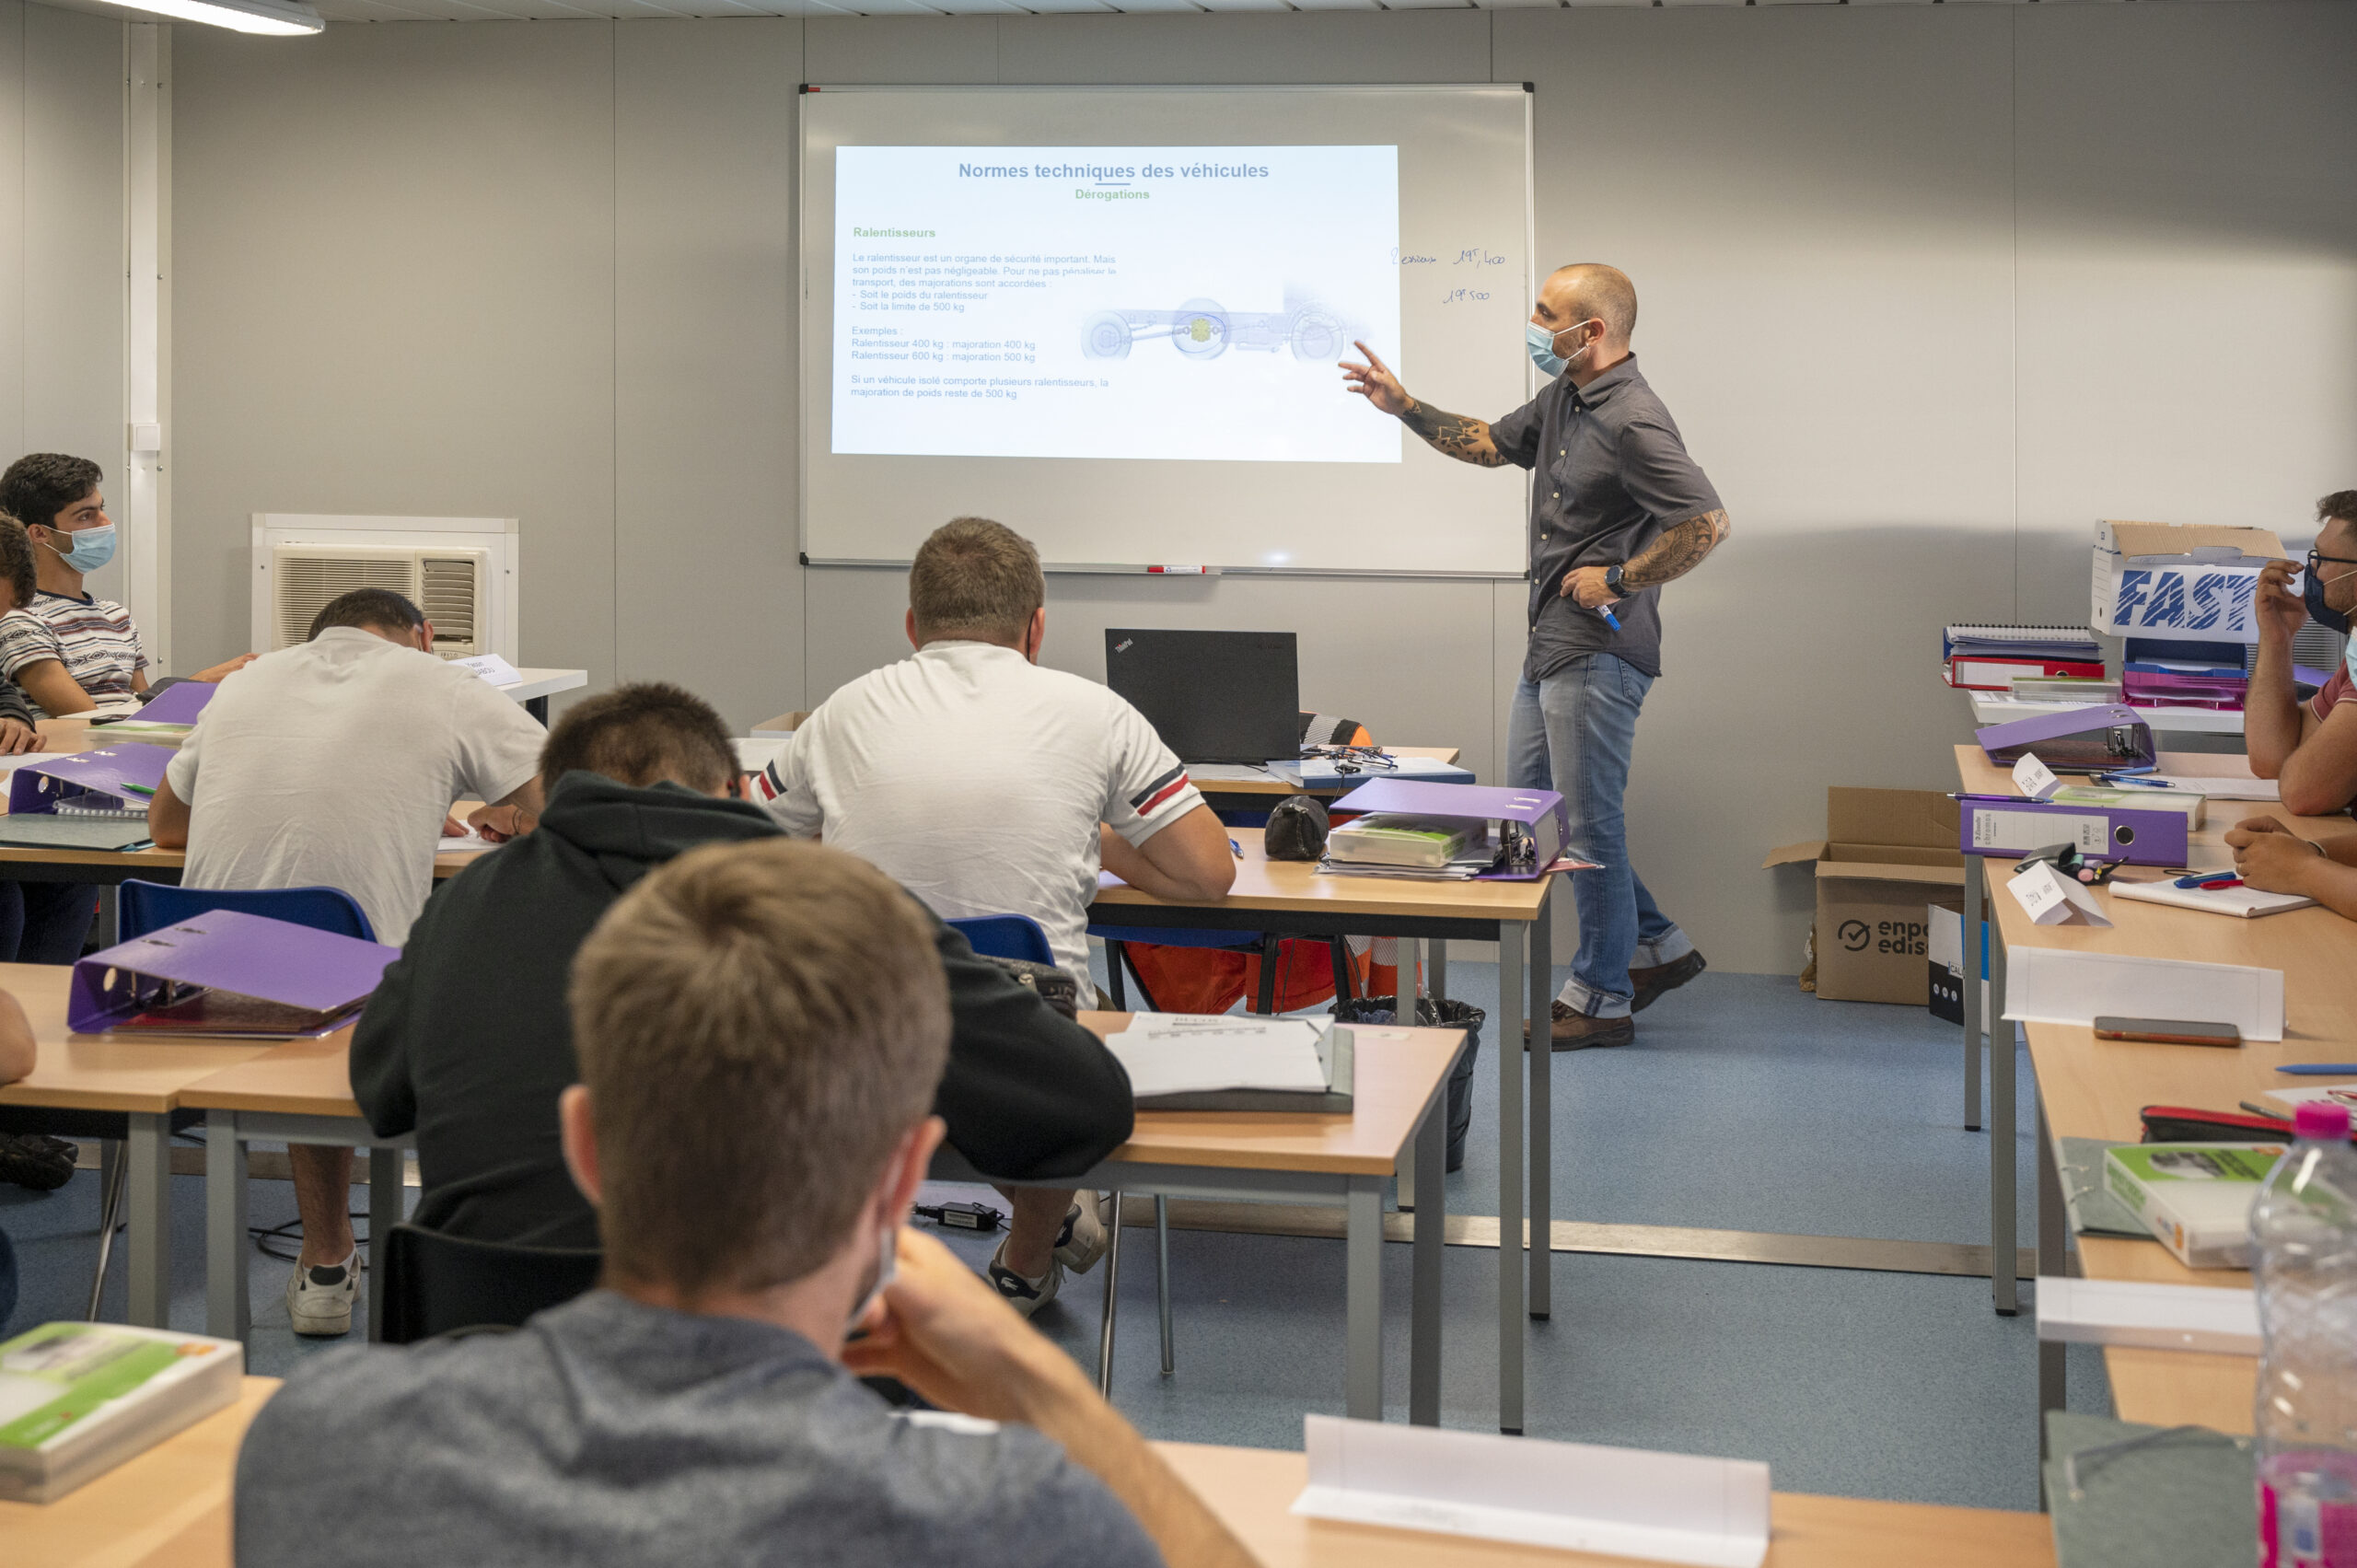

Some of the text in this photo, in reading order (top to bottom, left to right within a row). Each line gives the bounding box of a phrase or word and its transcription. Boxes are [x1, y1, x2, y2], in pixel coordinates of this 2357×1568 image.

[958, 161, 1270, 183] Normes techniques des véhicules
[1074, 188, 1150, 202] Dérogations
[853, 226, 936, 238] Ralentisseurs
[853, 253, 865, 262] Le
[867, 253, 921, 262] ralentisseur
[923, 254, 937, 262] est
[955, 256, 987, 265] organe
[990, 254, 1003, 262] de
[1004, 254, 1041, 263] sécurité
[1094, 254, 1116, 263] Mais
[872, 265, 897, 275] poids
[924, 268, 941, 276] pas
[1004, 266, 1025, 275] Pour
[1042, 269, 1061, 277] pas
[919, 279, 972, 289] majorations
[860, 290, 878, 298] Soit
[892, 291, 917, 300] poids
[919, 291, 931, 299] du
[934, 291, 988, 300] ralentisseur
[860, 302, 878, 310] Soit
[881, 302, 888, 310] la
[891, 302, 916, 311] limite
[919, 303, 930, 311] de
[934, 302, 951, 311] 500
[953, 303, 965, 313] kg
[852, 326, 898, 337] Exemples
[852, 338, 910, 347] Ralentisseur
[911, 339, 930, 348] 400
[933, 340, 944, 350] kg
[952, 340, 1002, 351] majoration
[1004, 340, 1022, 349] 400
[1024, 340, 1036, 352] kg
[852, 351, 910, 361] Ralentisseur
[911, 351, 930, 360] 600
[933, 352, 943, 363] kg
[952, 352, 1001, 363] majoration
[1004, 353, 1021, 361] 500
[1024, 354, 1035, 364] kg
[852, 375, 860, 383] Si
[877, 376, 916, 384] véhicule
[919, 376, 940, 385] isolé
[943, 377, 987, 387] comporte
[989, 377, 1031, 388] plusieurs
[1100, 377, 1109, 387] la
[851, 388, 1016, 401] majoration de poids reste de 500 kg
[2114, 569, 2258, 633] FAST
[1878, 936, 1928, 956] edis
